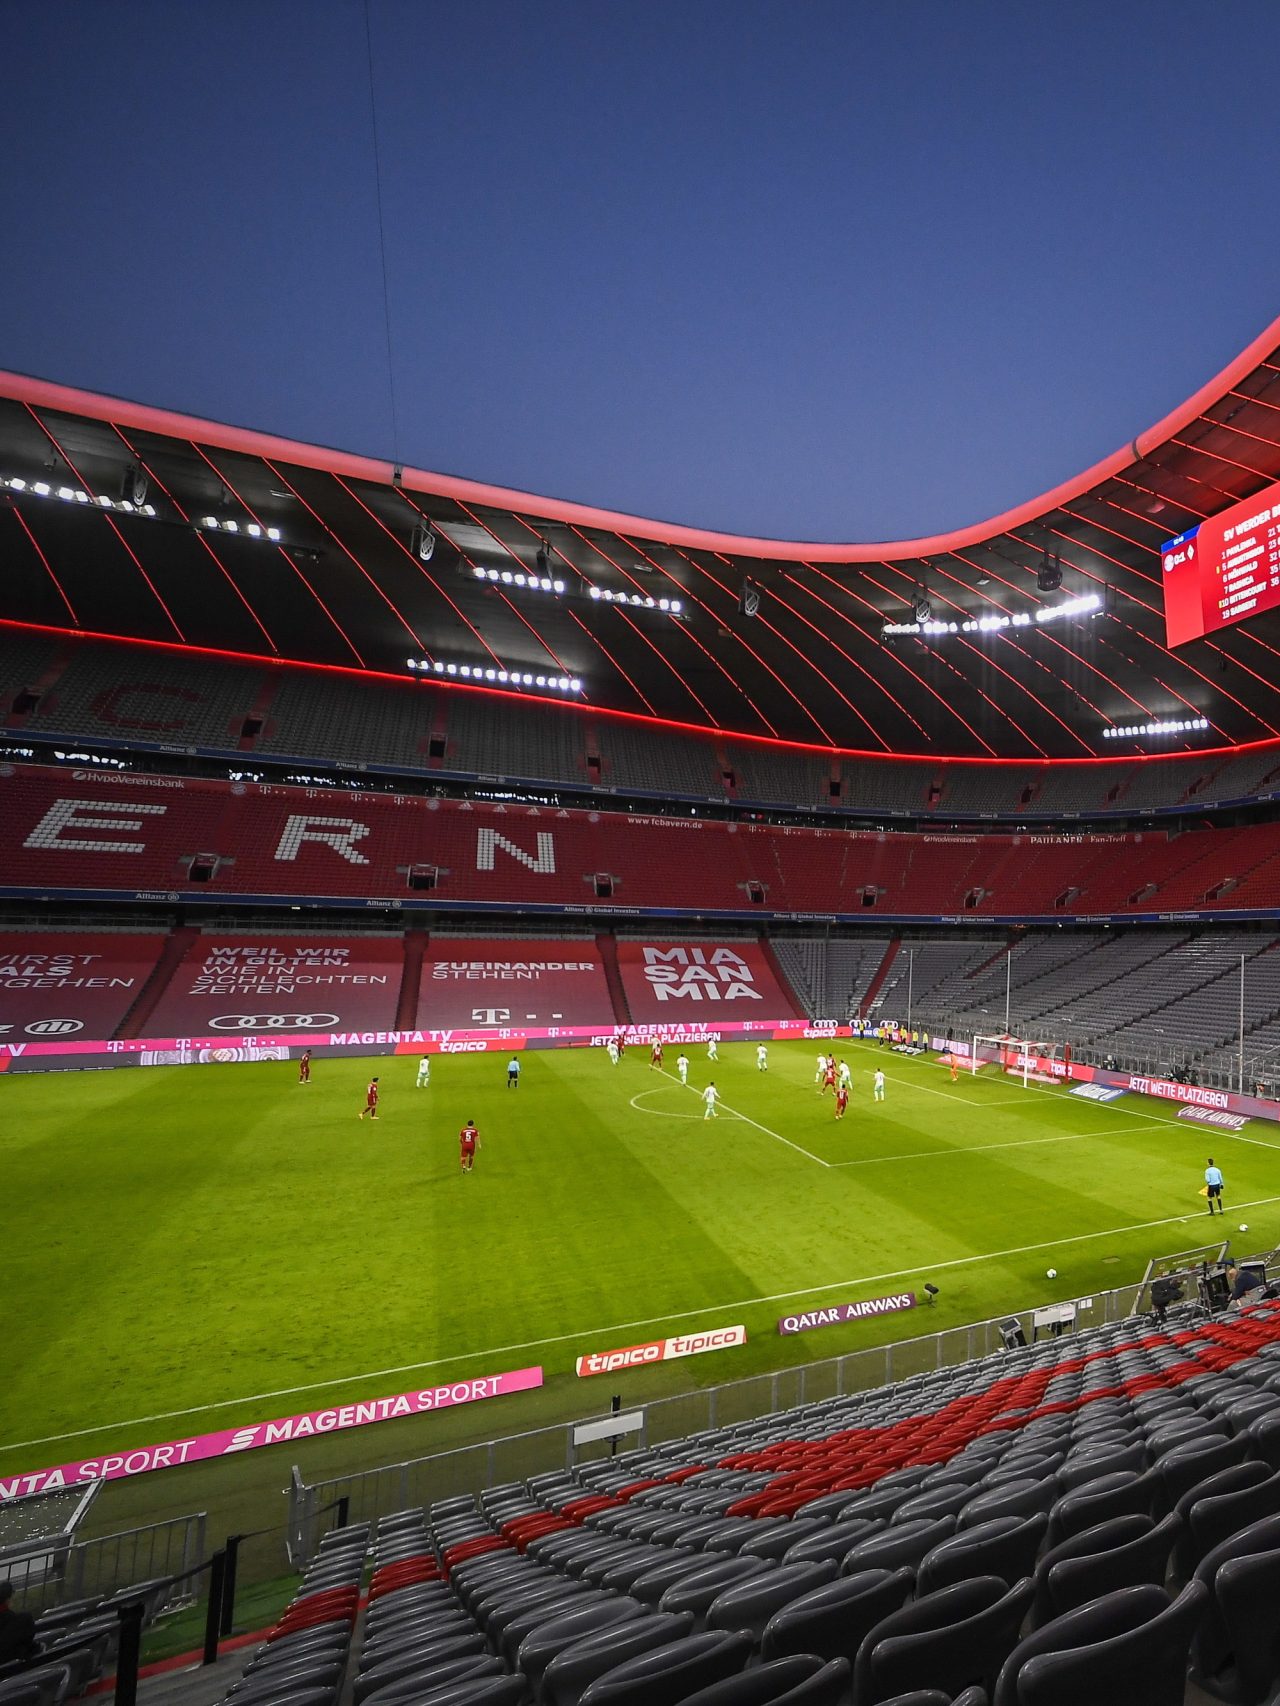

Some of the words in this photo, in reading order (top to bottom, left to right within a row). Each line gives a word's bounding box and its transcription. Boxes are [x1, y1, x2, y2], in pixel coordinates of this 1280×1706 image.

[1235, 509, 1271, 536] WERDER
[87, 772, 185, 789] HypoVereinsbank
[23, 799, 167, 853] E
[274, 814, 370, 865] R
[476, 828, 556, 873] N
[212, 947, 284, 956] WEIL
[295, 948, 350, 957] WIR
[643, 948, 746, 965] MIA
[0, 955, 102, 965] IRST
[205, 956, 236, 965] IN
[246, 957, 350, 967] GUTEN,
[202, 966, 257, 975] WIE
[267, 966, 295, 975] IN
[433, 962, 594, 971] ZUEINANDER
[432, 970, 540, 980] STEHEN!
[644, 965, 754, 982] SAN
[0, 978, 134, 988] GEHEN
[195, 975, 387, 985] SCHLECHTEN
[188, 984, 295, 994] ZEITEN
[653, 983, 763, 1000] MIA
[614, 1024, 685, 1035] MAGENTA
[689, 1023, 708, 1034] TV
[803, 1027, 836, 1039] tipico
[330, 1031, 424, 1045] MAGENTA
[429, 1030, 453, 1044] TV
[624, 1034, 657, 1044] WETT
[661, 1032, 721, 1044] PLATZIEREN
[439, 1041, 487, 1053] tipico
[1129, 1077, 1149, 1094] JETZT
[1151, 1080, 1175, 1097] WETTE
[1178, 1084, 1228, 1108] PLATZIEREN
[783, 1308, 840, 1332] QATAR
[846, 1294, 911, 1318] AIRWAYS
[587, 1346, 660, 1372] tipico
[672, 1332, 737, 1353] tipico
[264, 1396, 412, 1444] MAGENTA
[416, 1376, 503, 1410] SPORT
[76, 1440, 196, 1482] SPORT
